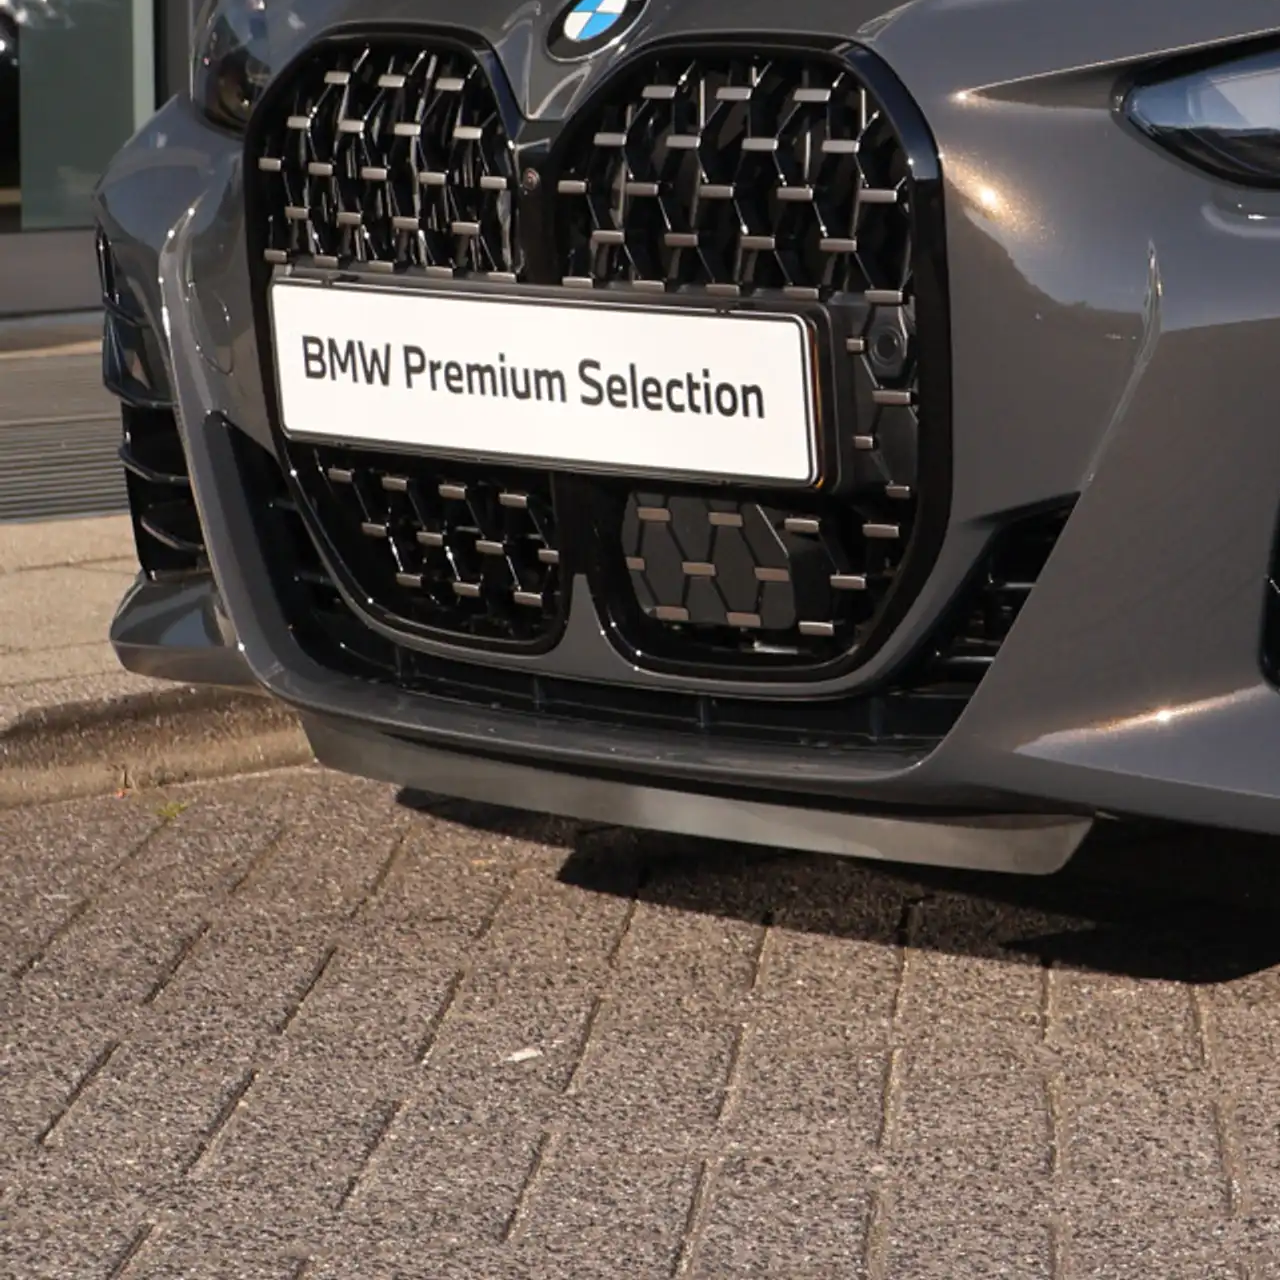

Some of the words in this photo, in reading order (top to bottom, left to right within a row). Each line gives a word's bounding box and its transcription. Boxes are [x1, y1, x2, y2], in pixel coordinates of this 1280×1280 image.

[301, 335, 391, 387] BMW
[403, 344, 567, 403] Premium
[578, 359, 765, 419] Selection
